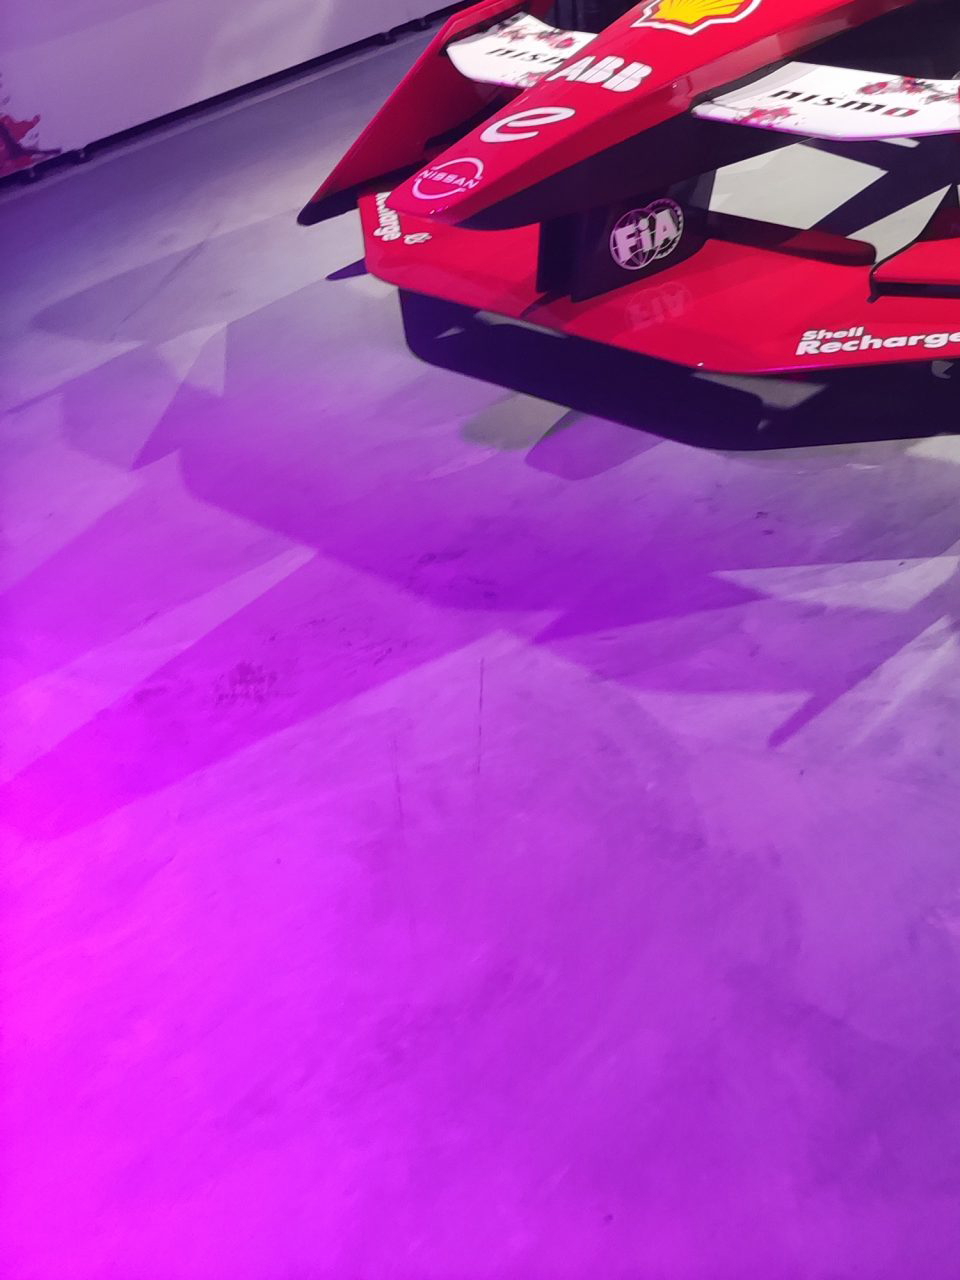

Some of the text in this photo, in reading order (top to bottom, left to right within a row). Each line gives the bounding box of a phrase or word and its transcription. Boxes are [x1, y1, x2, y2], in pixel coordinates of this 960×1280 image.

[545, 56, 652, 92] ABB
[420, 170, 480, 189] NISSAN
[614, 208, 681, 265] FIA
[801, 326, 865, 341] Shell
